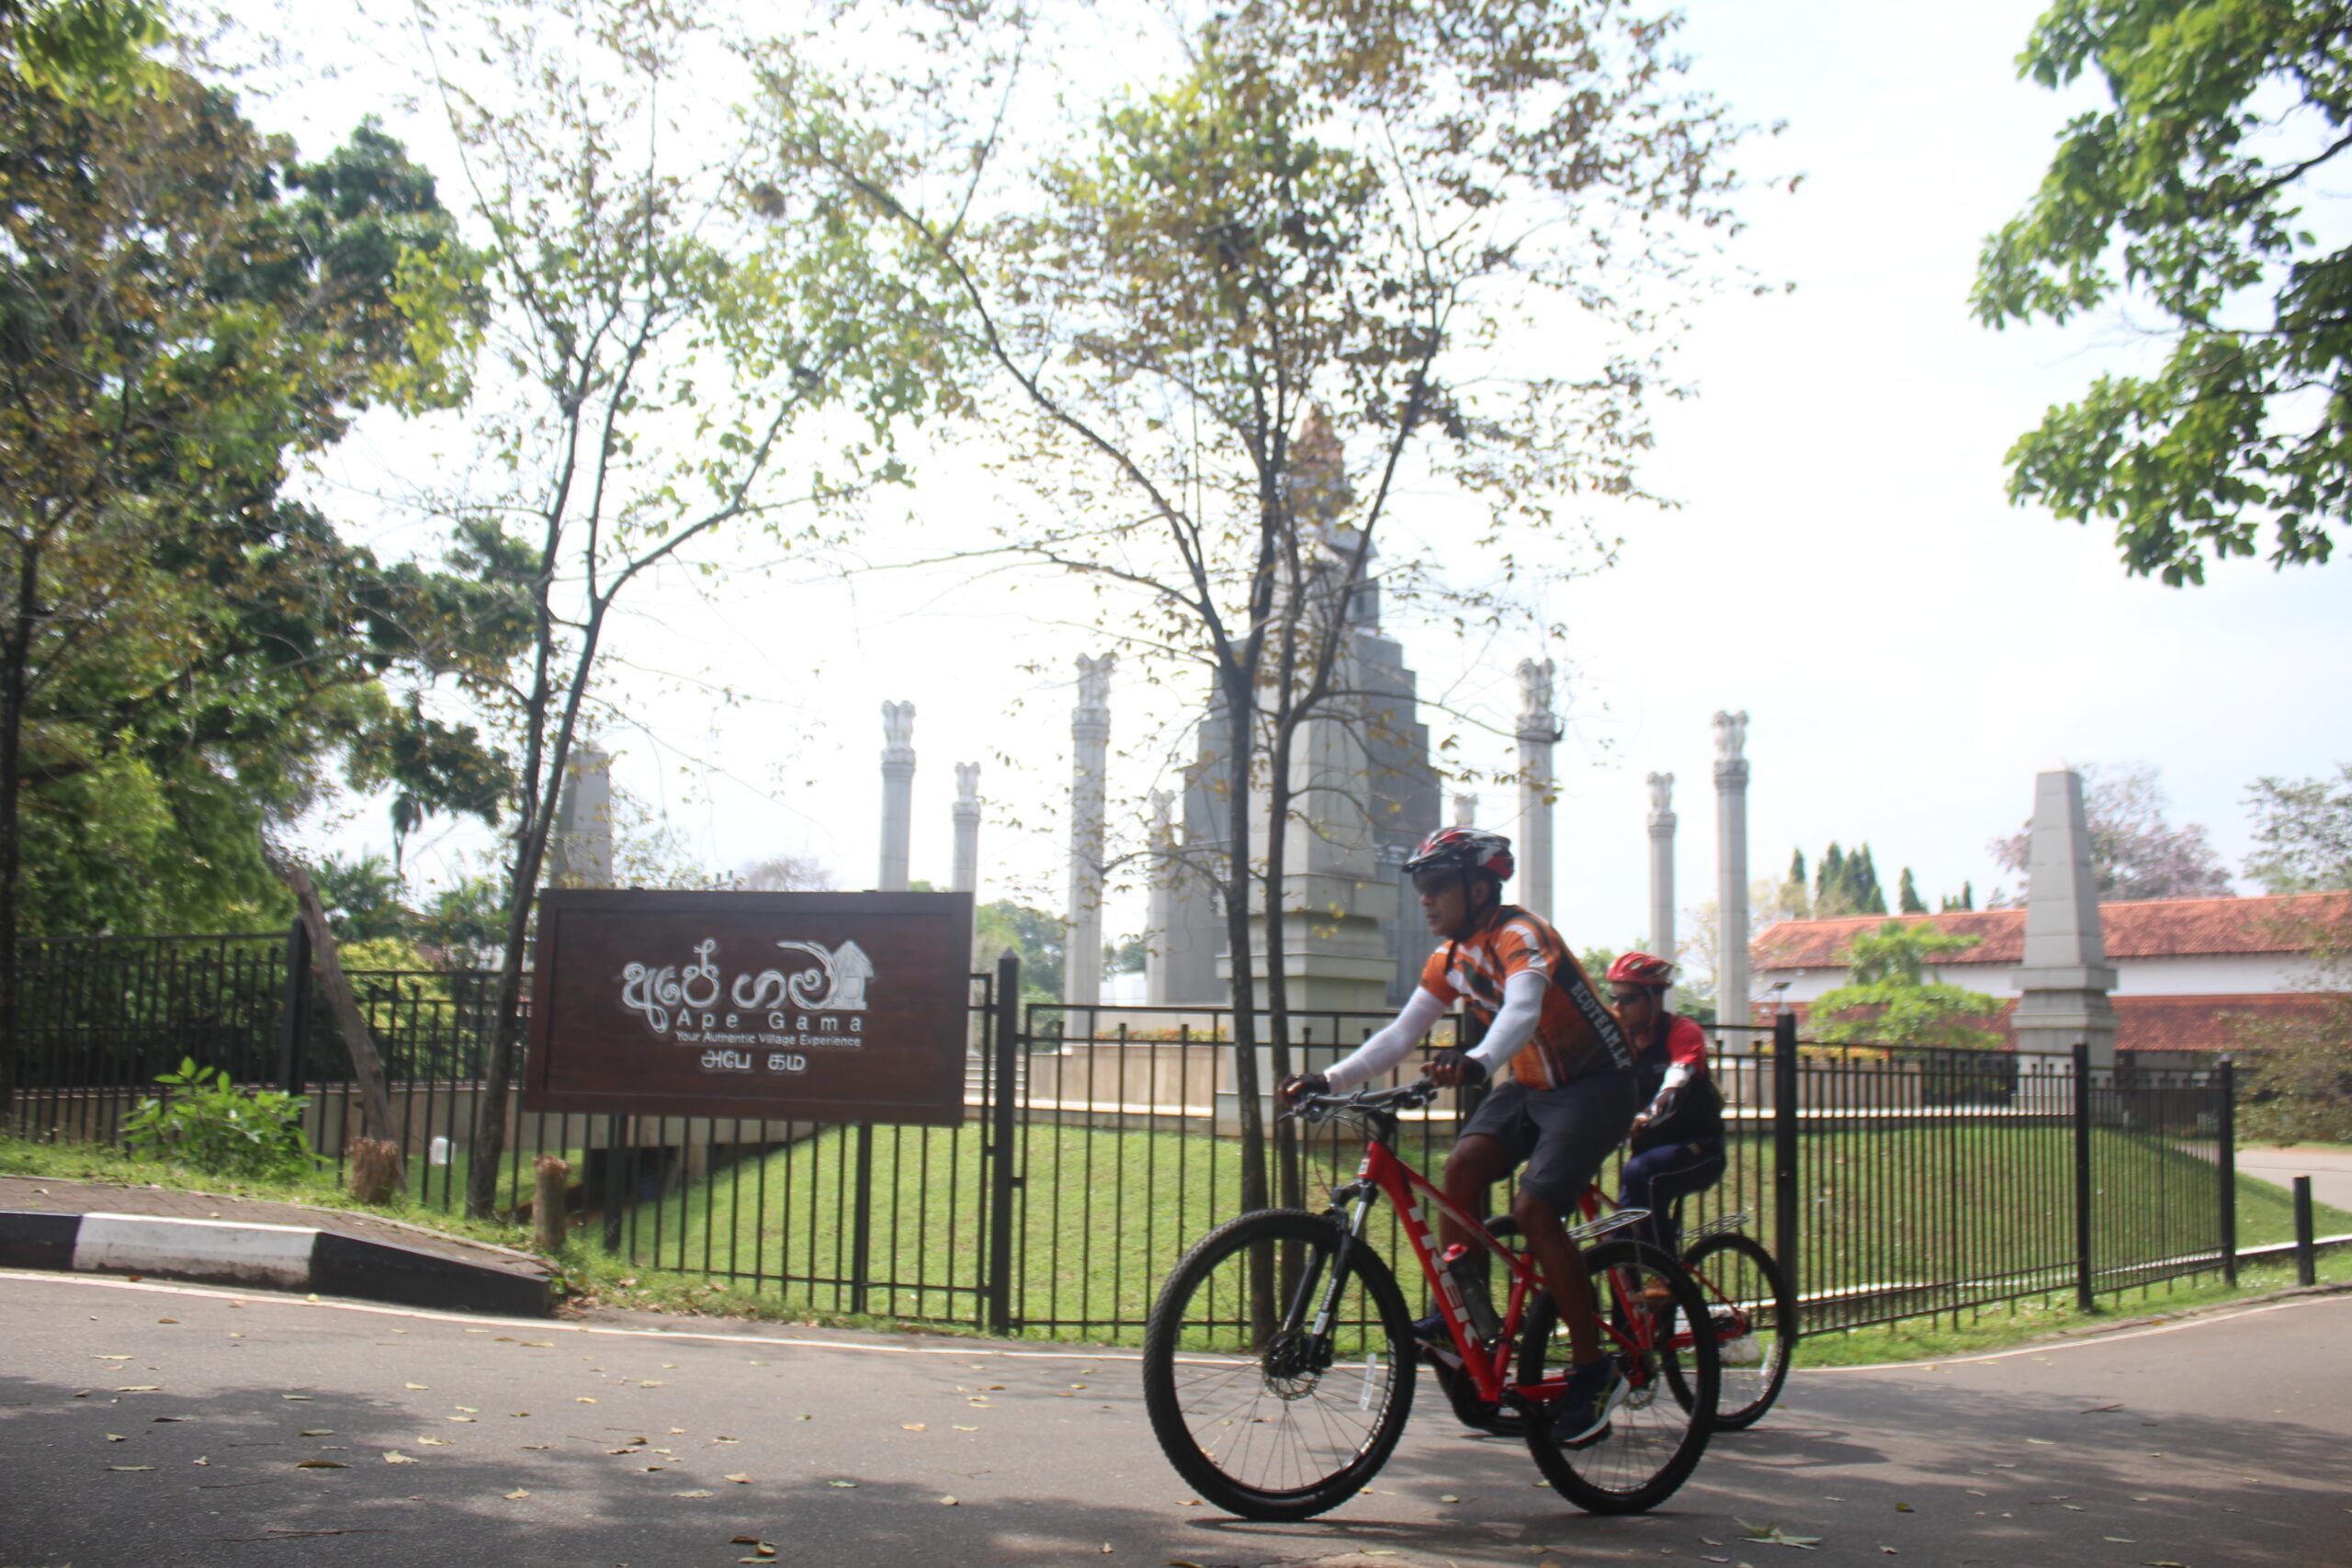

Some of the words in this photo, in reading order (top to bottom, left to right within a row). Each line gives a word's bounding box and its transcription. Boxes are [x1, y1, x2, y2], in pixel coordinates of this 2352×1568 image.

[622, 938, 720, 1033] අපේ
[731, 941, 841, 1010] ගම
[676, 1008, 739, 1029] Ape
[768, 1011, 862, 1032] Gama
[675, 1030, 701, 1042] Your
[702, 1031, 755, 1043] Authentic
[758, 1032, 796, 1045] Village
[799, 1033, 862, 1047] Experience
[767, 1054, 807, 1071] கம
[1408, 1194, 1480, 1349] TREK
